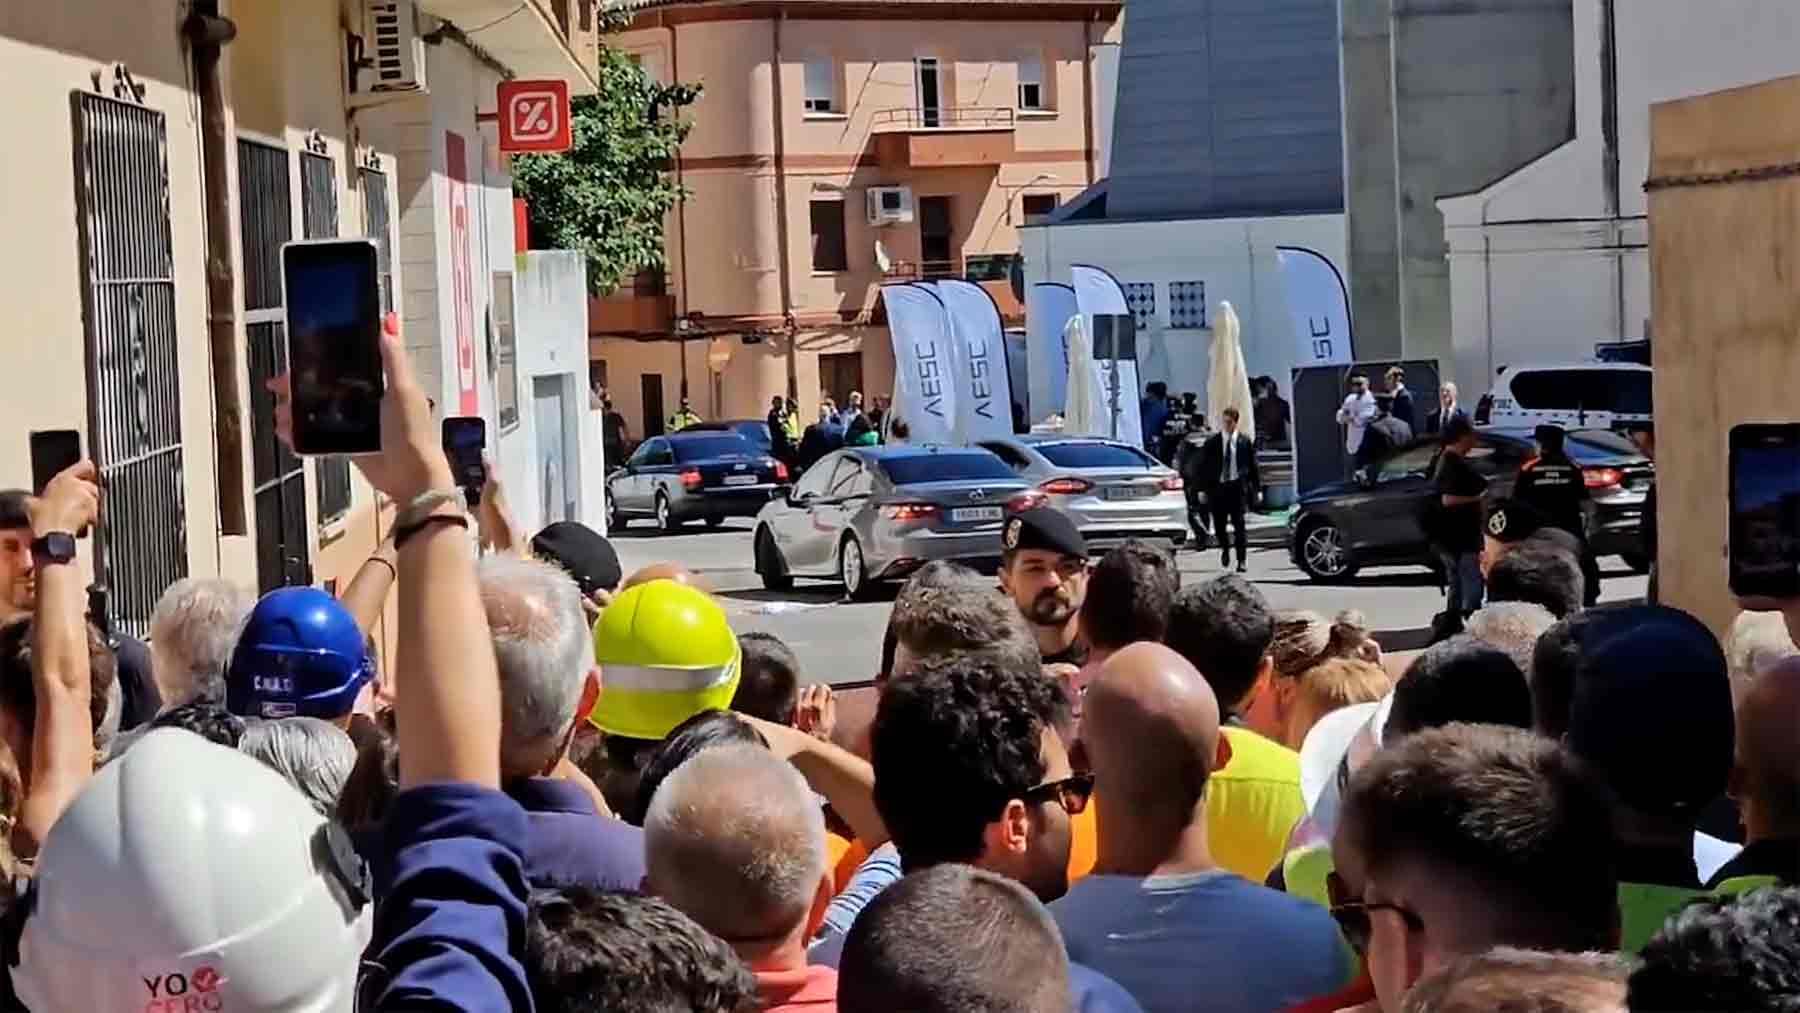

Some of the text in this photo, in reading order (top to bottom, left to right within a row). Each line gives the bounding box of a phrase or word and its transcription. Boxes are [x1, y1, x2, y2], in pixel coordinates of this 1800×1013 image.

[915, 341, 944, 417] AESC
[968, 340, 993, 420] AESC
[143, 973, 187, 998] YO
